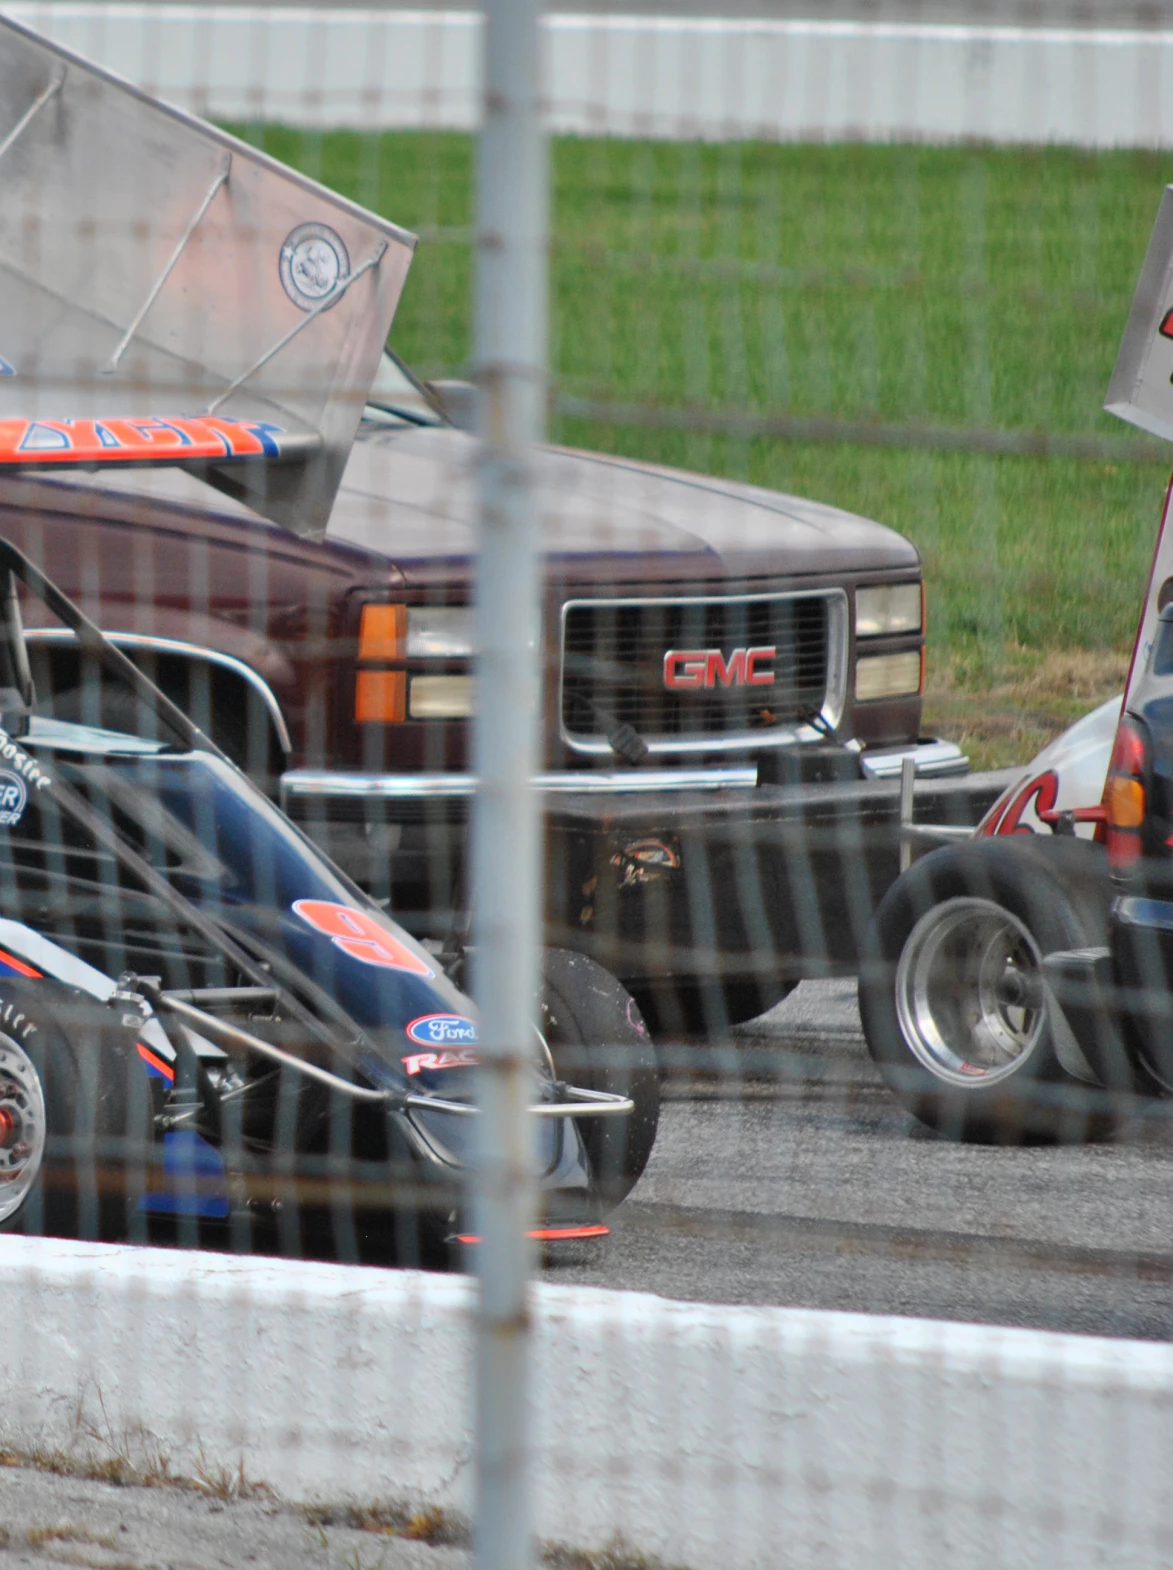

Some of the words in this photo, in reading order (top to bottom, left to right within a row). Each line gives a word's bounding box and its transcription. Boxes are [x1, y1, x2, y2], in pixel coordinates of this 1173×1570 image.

[664, 645, 776, 689] GMC
[293, 899, 435, 979] 9
[427, 1019, 479, 1041] Ford
